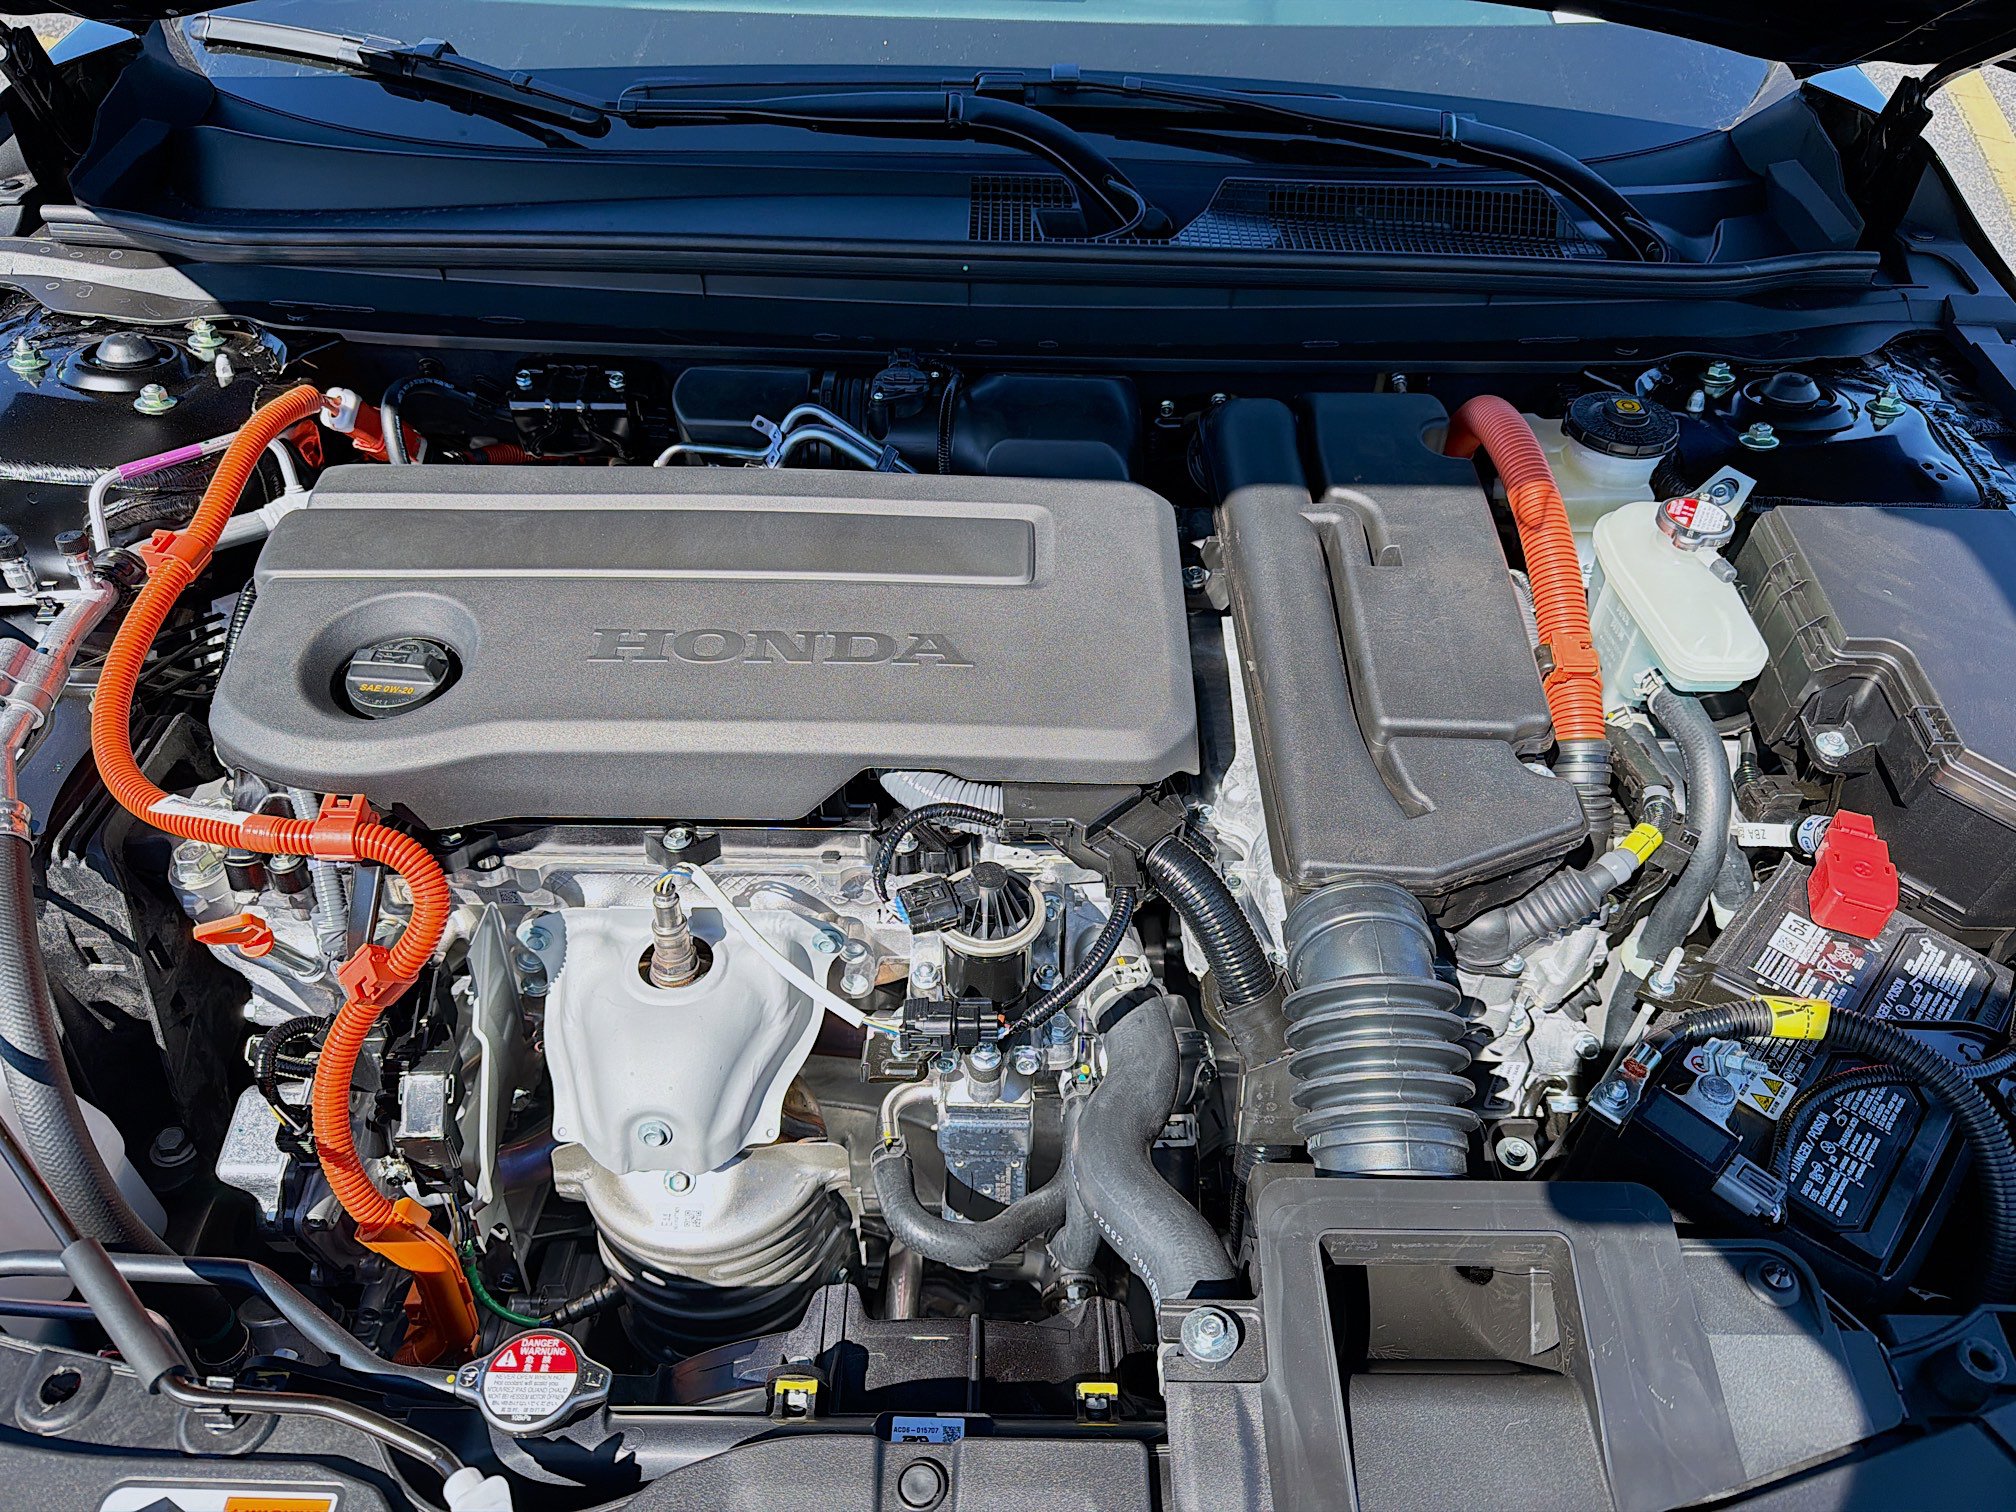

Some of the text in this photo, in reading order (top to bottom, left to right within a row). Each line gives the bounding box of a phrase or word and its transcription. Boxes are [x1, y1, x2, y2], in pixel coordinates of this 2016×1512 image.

[586, 628, 975, 667] HONDA
[359, 683, 415, 695] SAE 0W-20
[1788, 917, 1810, 937] 5A
[521, 1338, 560, 1347] DANGER
[520, 1347, 567, 1356] WARNUNG
